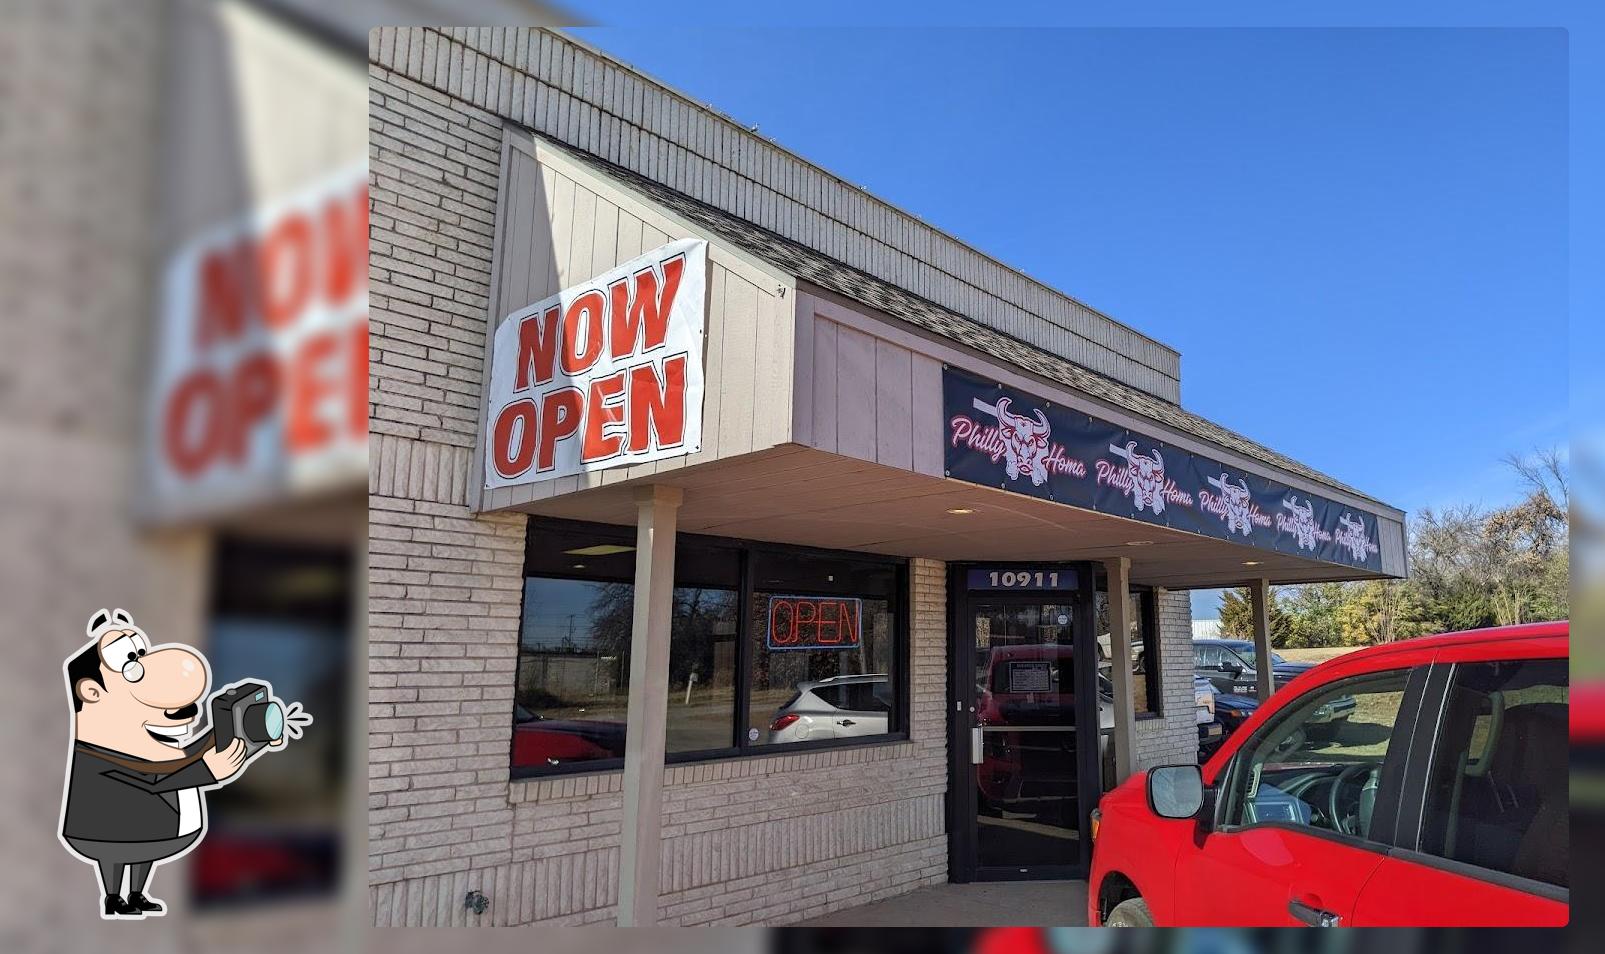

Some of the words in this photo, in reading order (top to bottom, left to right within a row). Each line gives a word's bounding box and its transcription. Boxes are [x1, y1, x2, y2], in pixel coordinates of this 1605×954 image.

[513, 252, 687, 393] NOW
[163, 317, 369, 480] OPE
[493, 351, 688, 479] OPEN
[951, 416, 1006, 462] Philly
[1041, 444, 1086, 478] Homa
[1095, 460, 1134, 496] Philly
[1161, 478, 1193, 506] Homa
[1199, 490, 1229, 520] Philly
[1248, 503, 1272, 528] Homa
[990, 571, 1058, 587] 10911
[771, 601, 858, 643] OPEN
